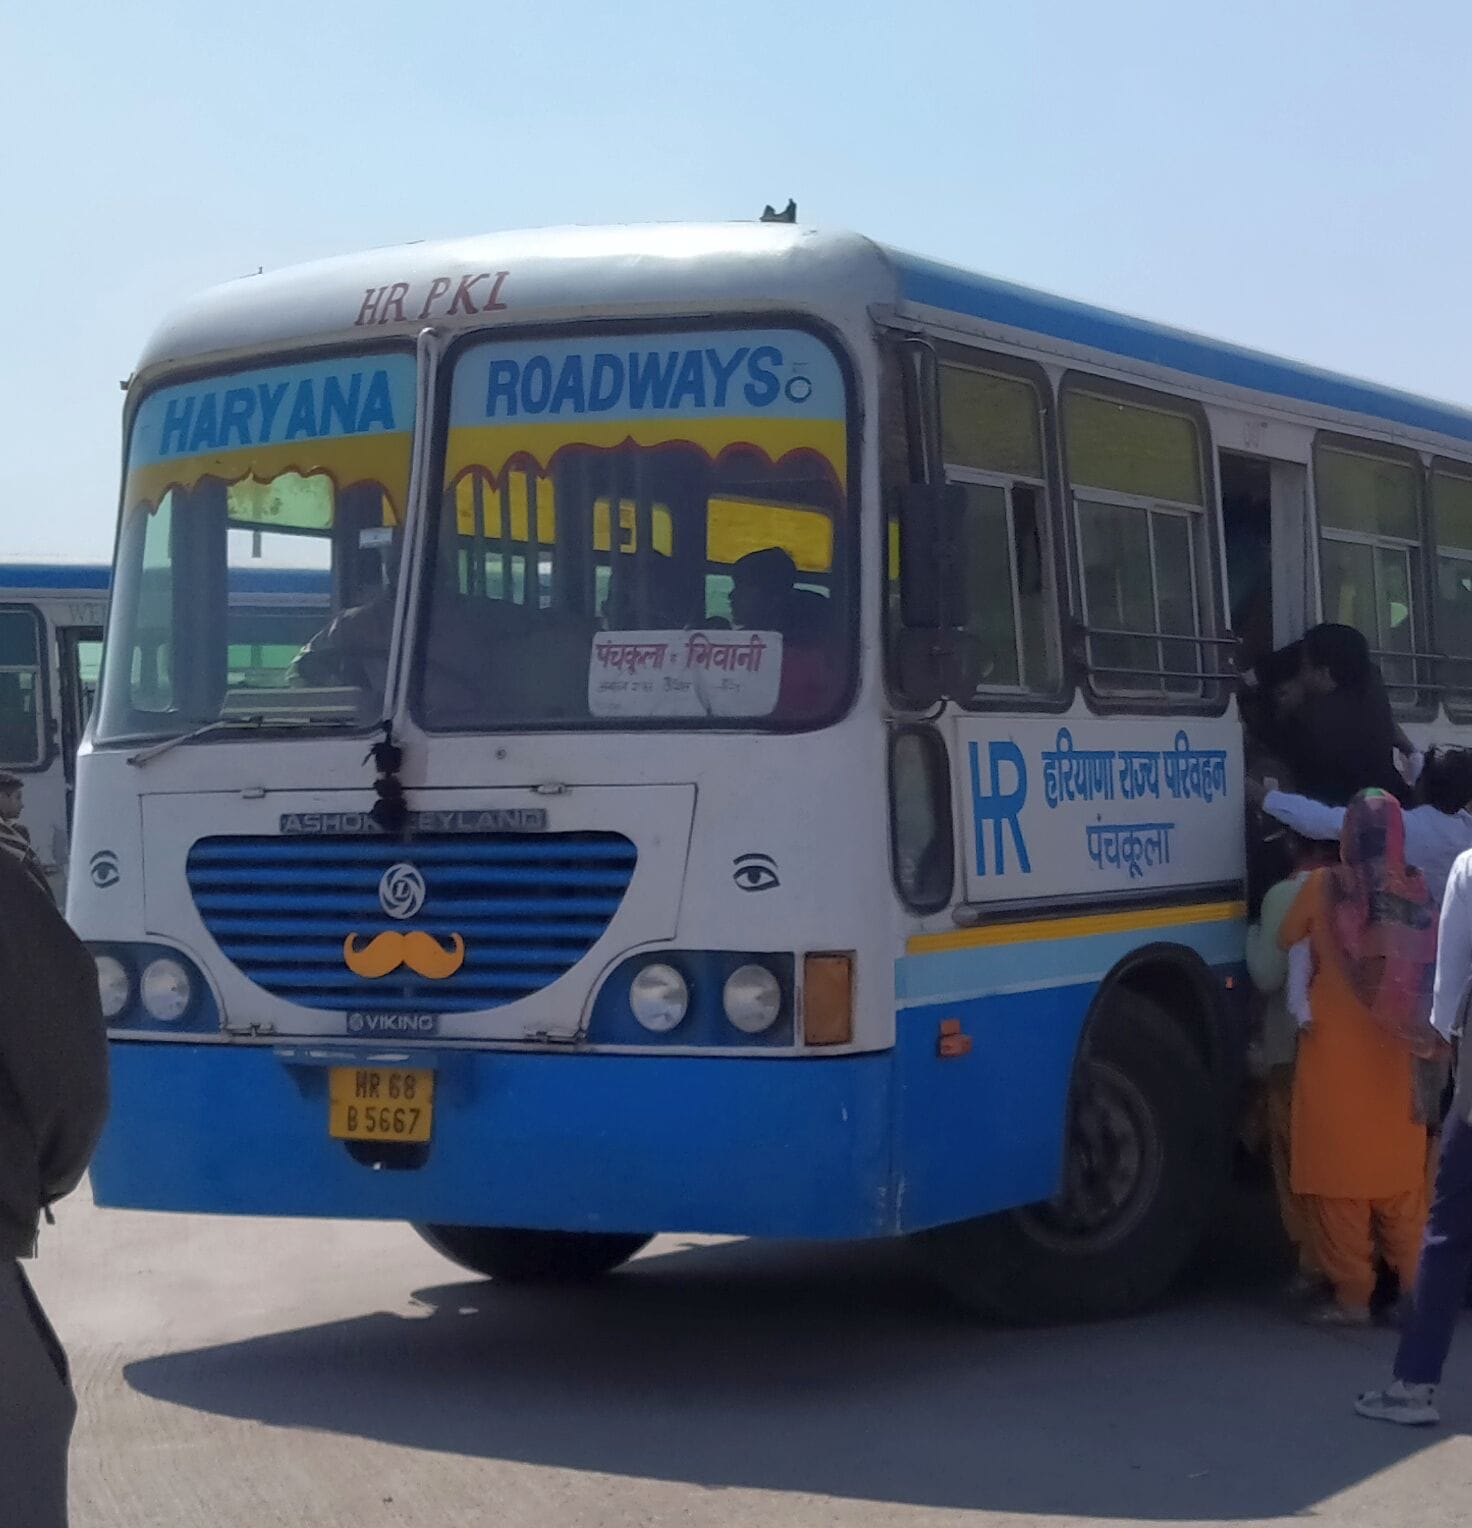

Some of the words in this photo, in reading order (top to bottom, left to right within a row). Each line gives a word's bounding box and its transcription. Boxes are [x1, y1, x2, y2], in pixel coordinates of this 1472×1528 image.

[355, 282, 409, 326] HR
[418, 270, 510, 319] PKL
[159, 370, 396, 455] HARYANA
[485, 345, 784, 417] ROADWAYS
[1041, 727, 1116, 808] हरियाणा
[1118, 750, 1161, 801] राज्य
[1162, 729, 1227, 803] परिवहन
[404, 811, 544, 830] EYLAND
[1086, 813, 1175, 878] पंचकूला
[365, 1014, 434, 1031] VIKING
[355, 1069, 380, 1098] HR
[388, 1073, 416, 1100] 68
